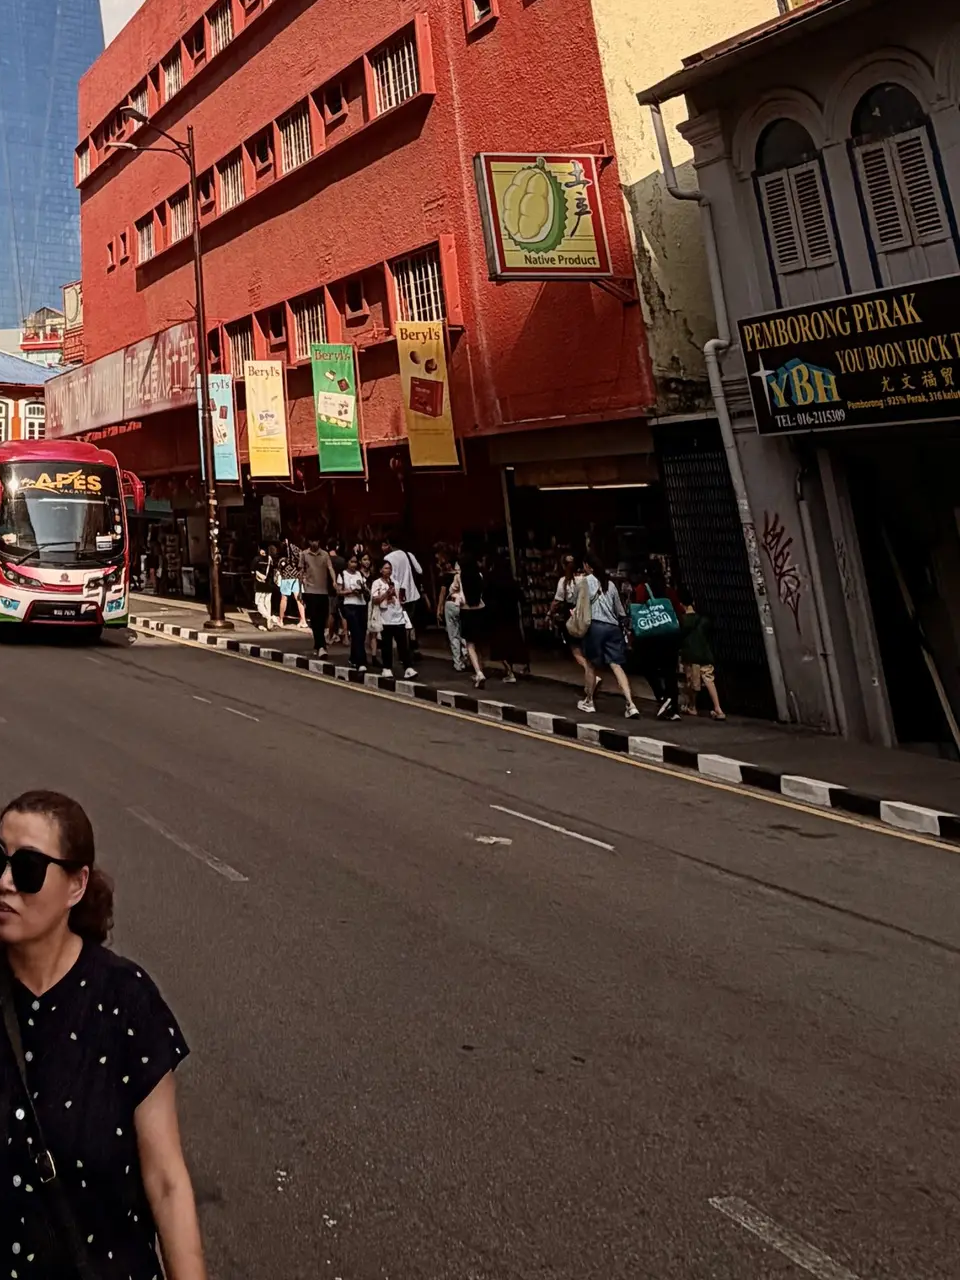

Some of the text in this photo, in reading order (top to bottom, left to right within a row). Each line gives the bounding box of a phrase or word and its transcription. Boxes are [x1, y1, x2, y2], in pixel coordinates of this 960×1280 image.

[524, 254, 597, 265] Native Product
[743, 293, 923, 352] PEMBORONG PERAK
[399, 328, 440, 344] Beryl's
[315, 349, 351, 362] Beryl's
[835, 347, 865, 374] YOU
[865, 341, 906, 370] BOON
[906, 334, 953, 365] HOCK
[248, 366, 280, 380] Beryl's
[209, 379, 230, 392] ryl's
[769, 364, 841, 408] YBH
[775, 409, 845, 427] TEL: 016-2115309
[35, 472, 102, 491] APES
